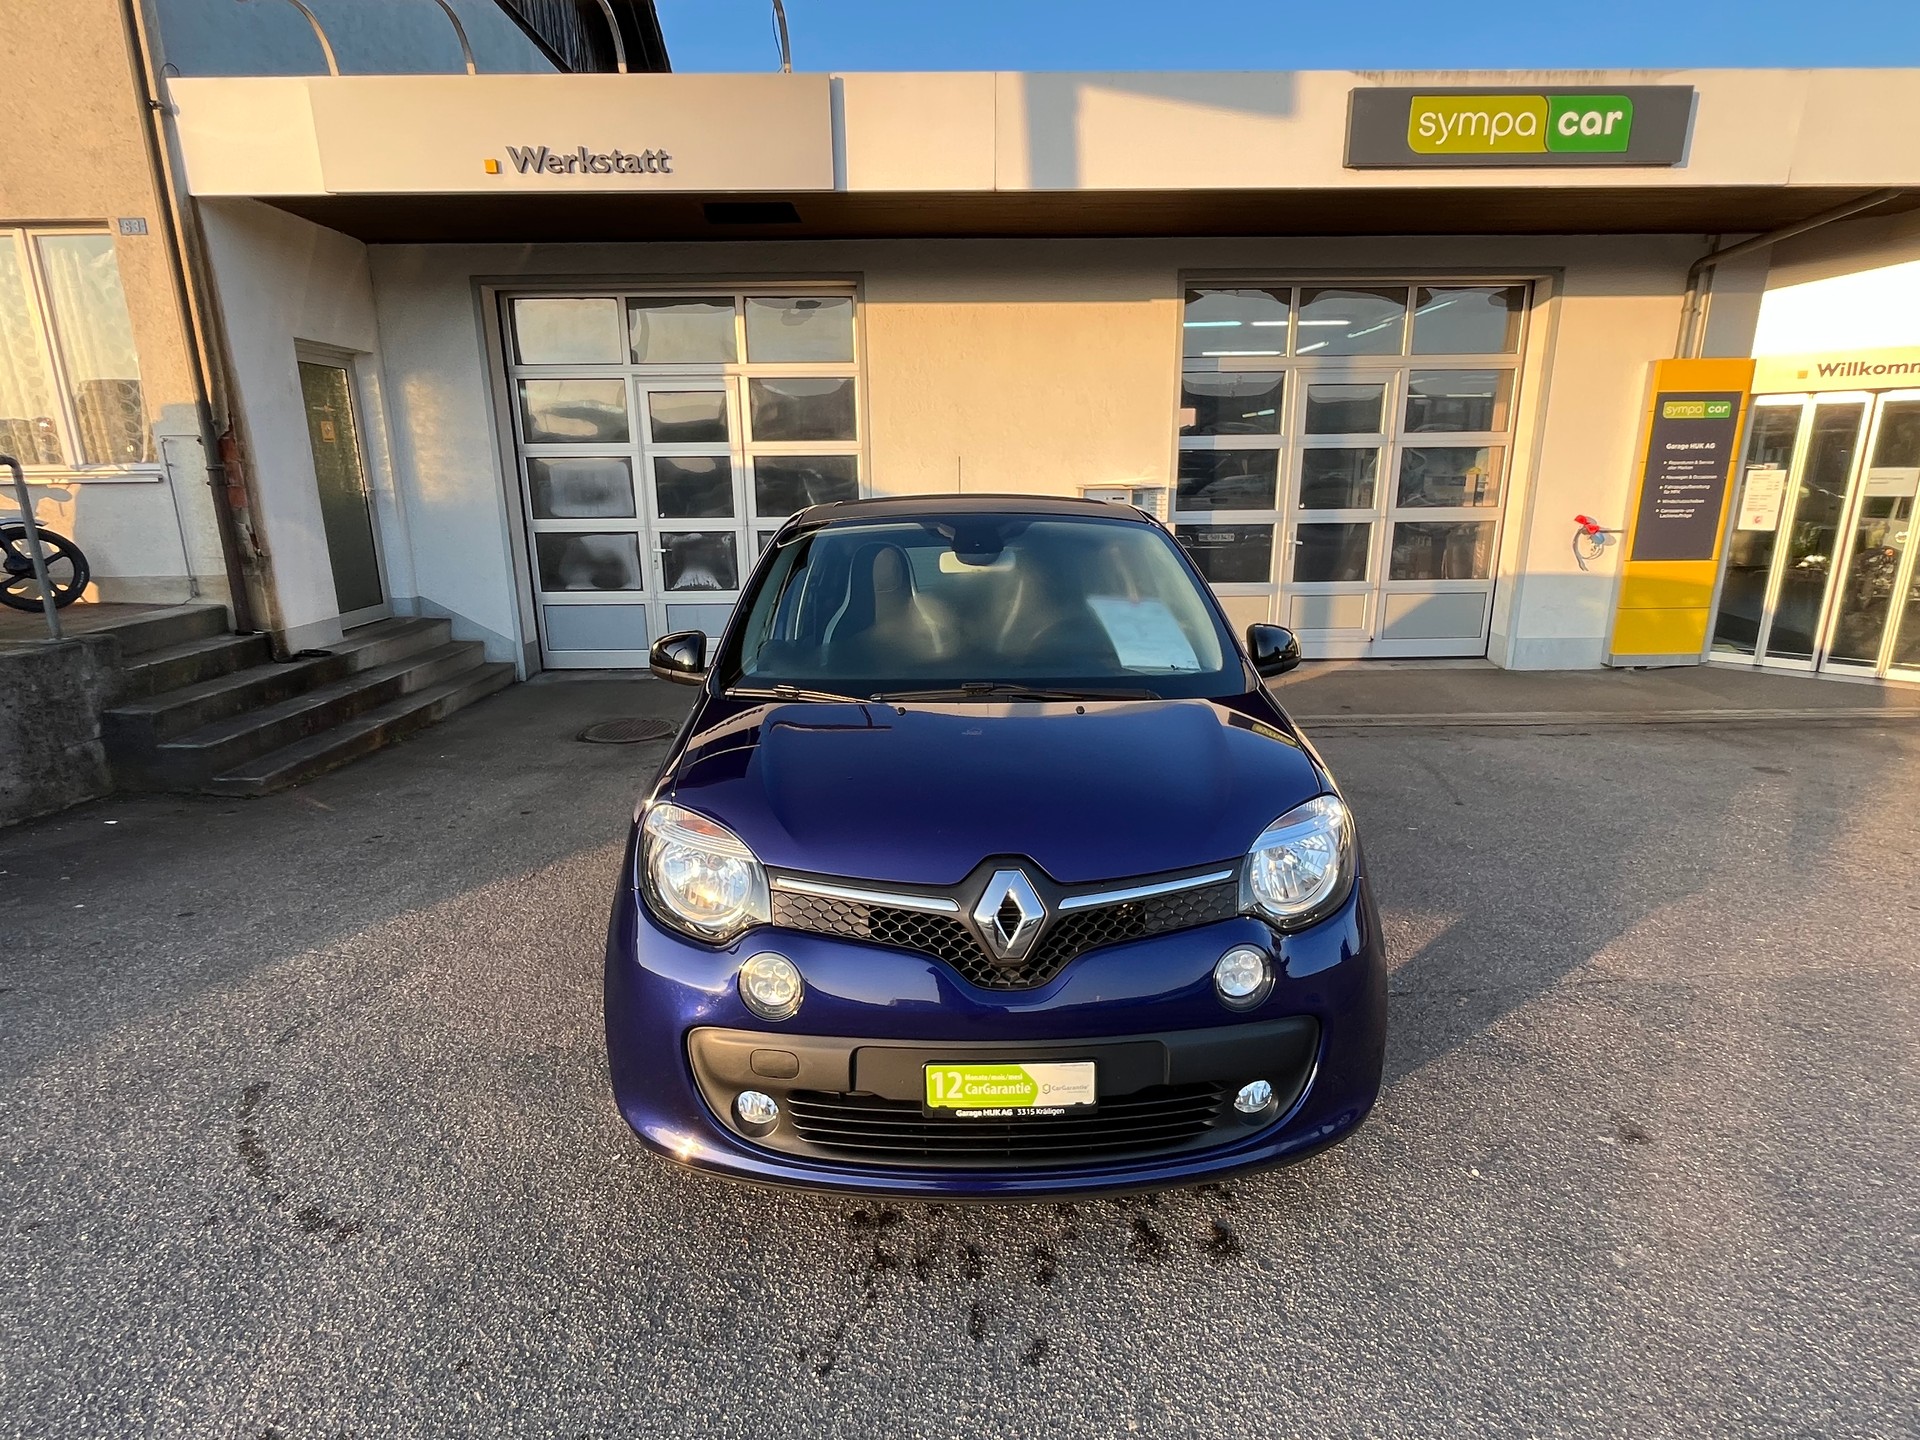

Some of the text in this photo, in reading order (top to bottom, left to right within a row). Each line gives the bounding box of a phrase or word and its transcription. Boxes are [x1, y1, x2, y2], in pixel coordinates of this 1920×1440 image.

[1418, 109, 1623, 145] sympa car
[506, 145, 673, 174] Werkstatt
[1707, 405, 1729, 414] car
[1665, 443, 1690, 451] Garage
[931, 1071, 964, 1099] 12
[955, 1109, 982, 1118] Garage
[982, 1108, 1001, 1116] HUK
[1000, 1108, 1013, 1116] AG
[1017, 1108, 1035, 1116] 3315
